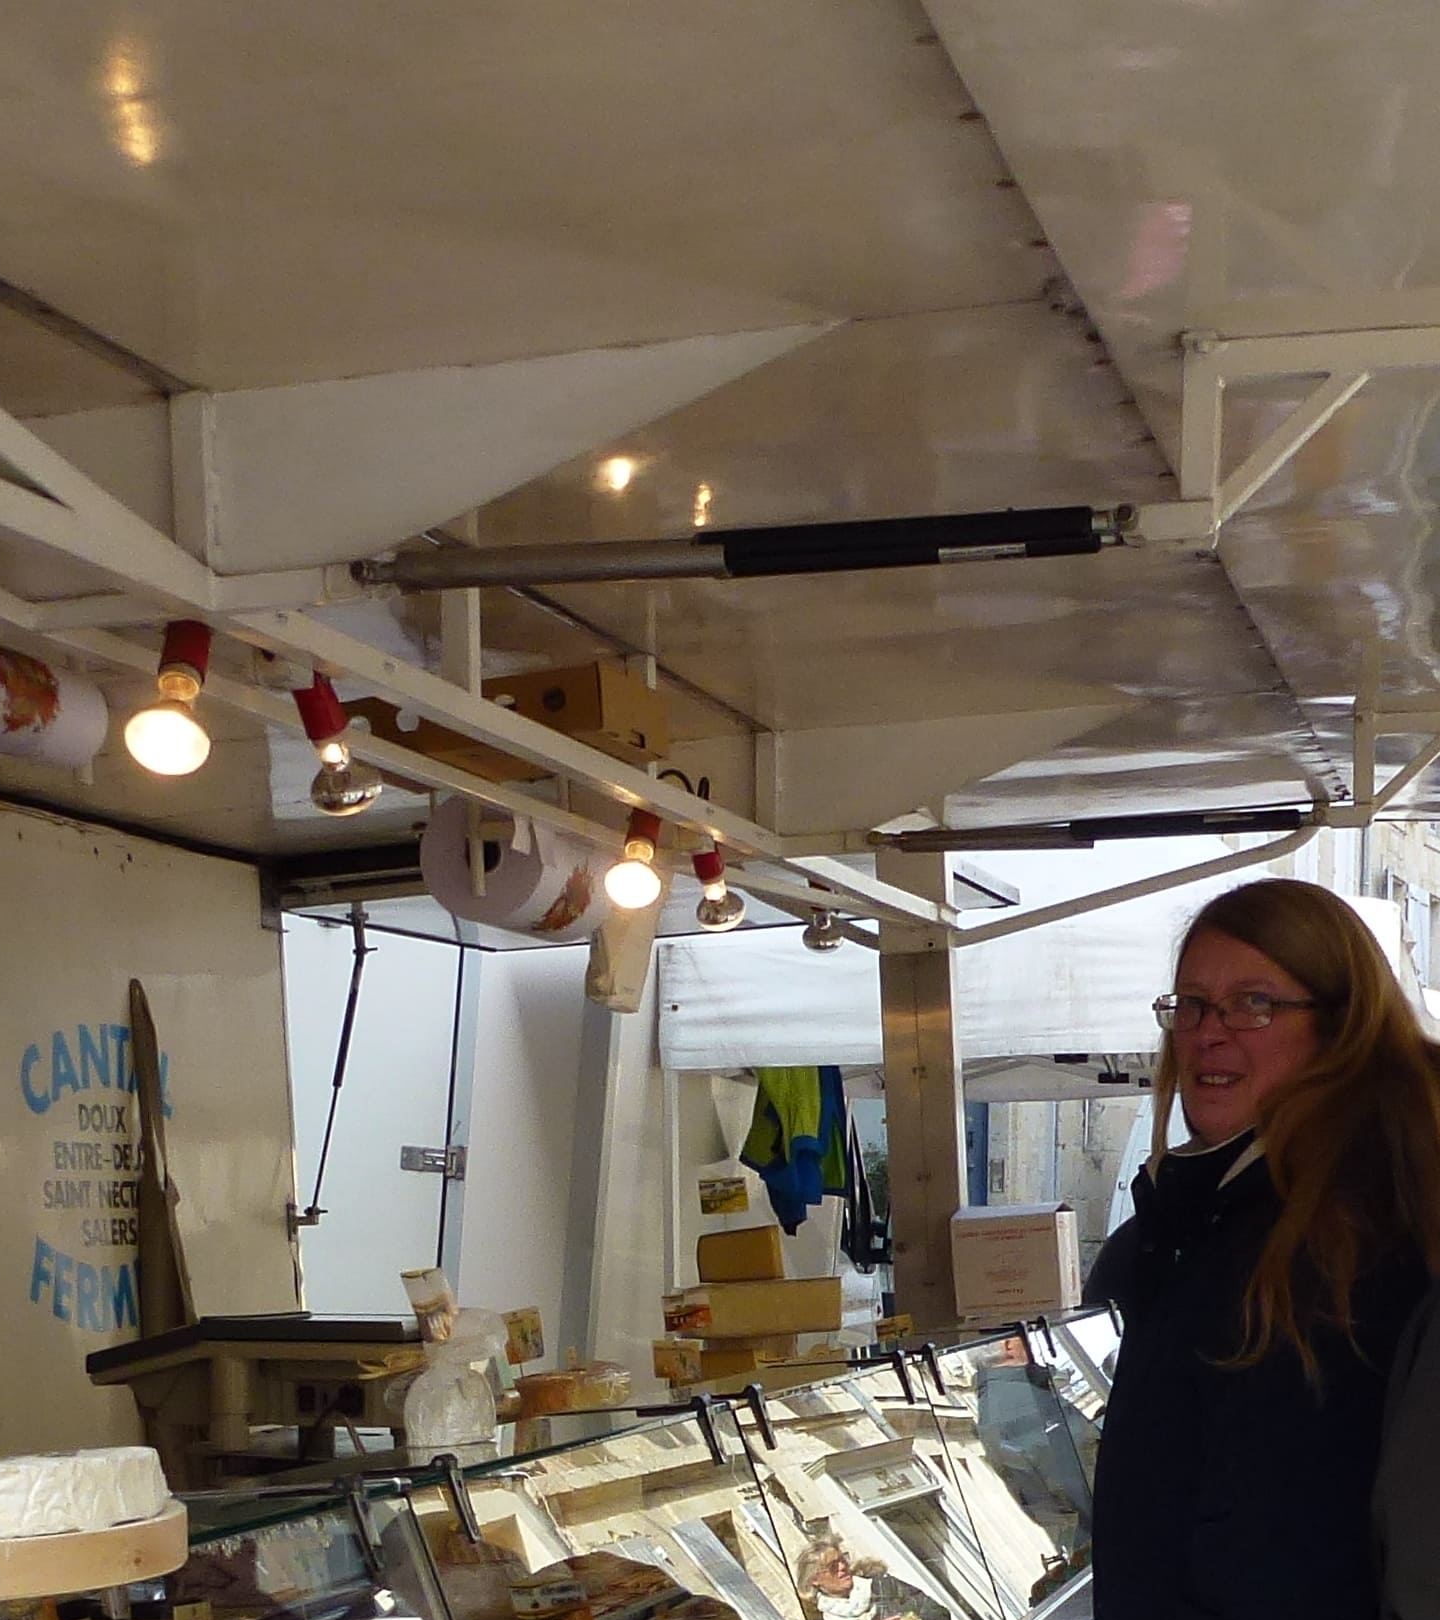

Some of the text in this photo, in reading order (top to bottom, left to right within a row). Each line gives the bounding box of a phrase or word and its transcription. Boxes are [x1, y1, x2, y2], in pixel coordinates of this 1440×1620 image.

[20, 1023, 173, 1119] CANTL
[78, 1104, 127, 1133] DOUX
[54, 1142, 143, 1170] ENTRE-DEU
[43, 1180, 139, 1209] SAINT NECT
[81, 1219, 137, 1246] SALERS
[30, 1233, 140, 1332] FERM
